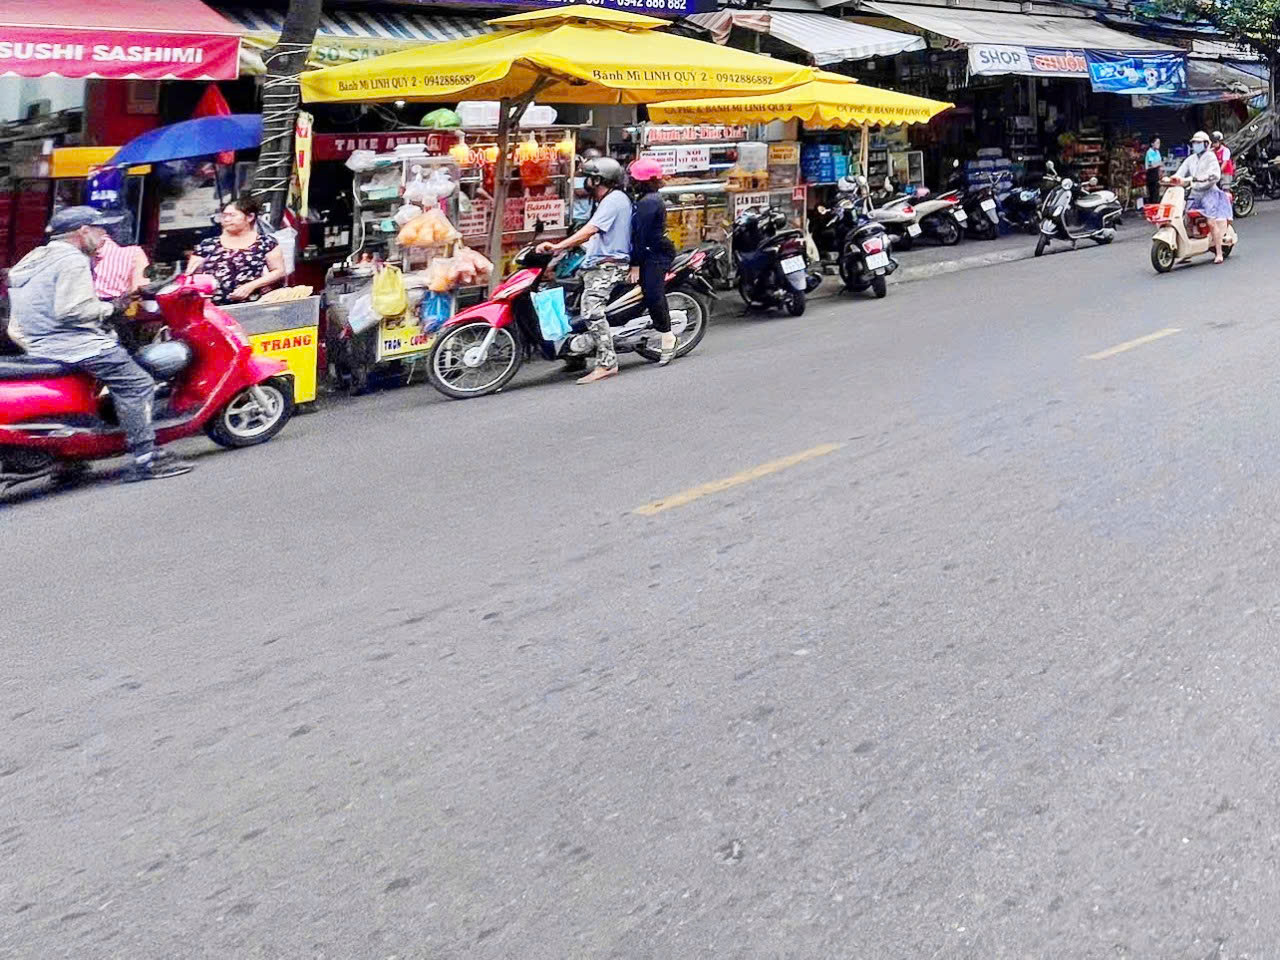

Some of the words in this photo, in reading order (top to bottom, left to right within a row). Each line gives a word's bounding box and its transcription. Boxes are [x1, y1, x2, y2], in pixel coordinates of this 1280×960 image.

[0, 41, 84, 61] SUSHI
[92, 45, 203, 64] SASHIMI
[981, 50, 1021, 65] SHOP
[371, 78, 389, 90] LINH
[411, 76, 417, 87] 2
[593, 70, 623, 81] Bánh
[627, 70, 641, 81] Mì
[644, 71, 671, 81] LINH
[701, 72, 707, 82] 2
[335, 138, 378, 151] TAKE
